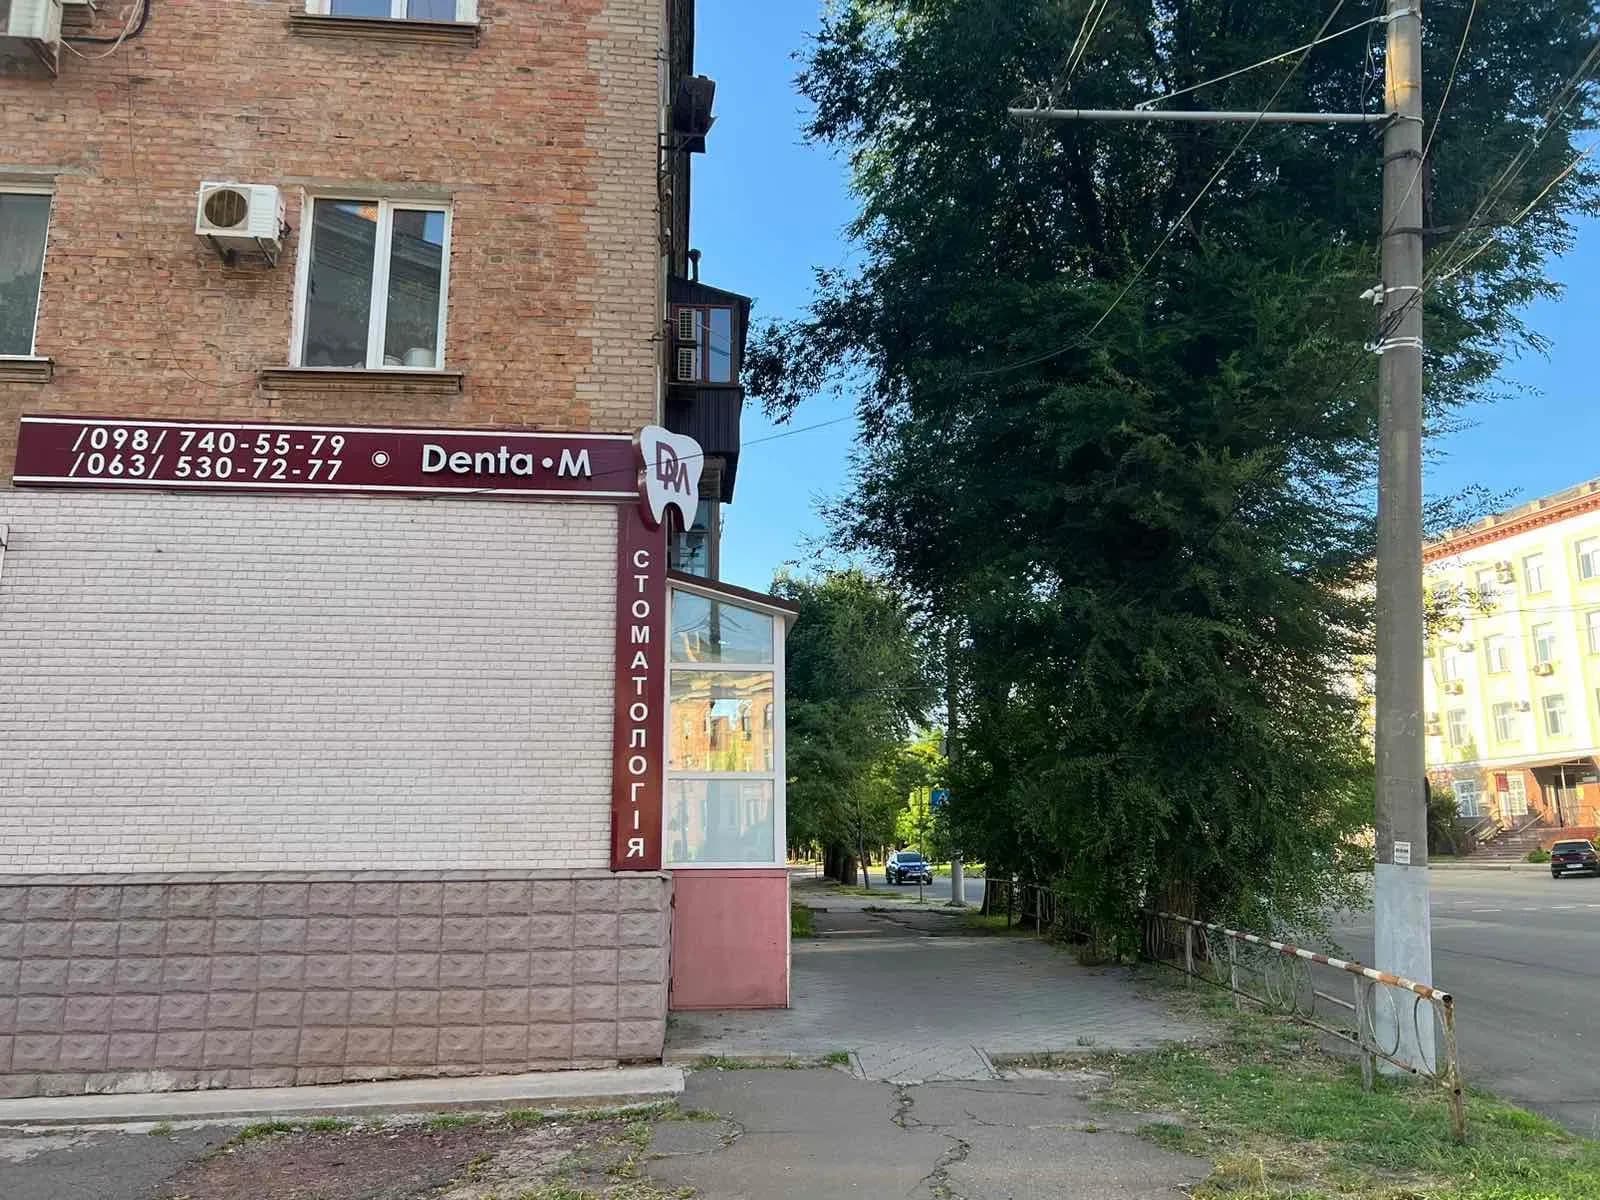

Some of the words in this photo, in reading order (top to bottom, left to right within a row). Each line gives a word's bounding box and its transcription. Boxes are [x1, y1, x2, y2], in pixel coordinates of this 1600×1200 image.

[72, 427, 167, 454] /098/
[180, 431, 345, 456] 740-55-79
[68, 452, 164, 479] /063/
[174, 456, 343, 481] 530-72-77
[626, 550, 650, 858] СТОМАТОЛОГІЯ
